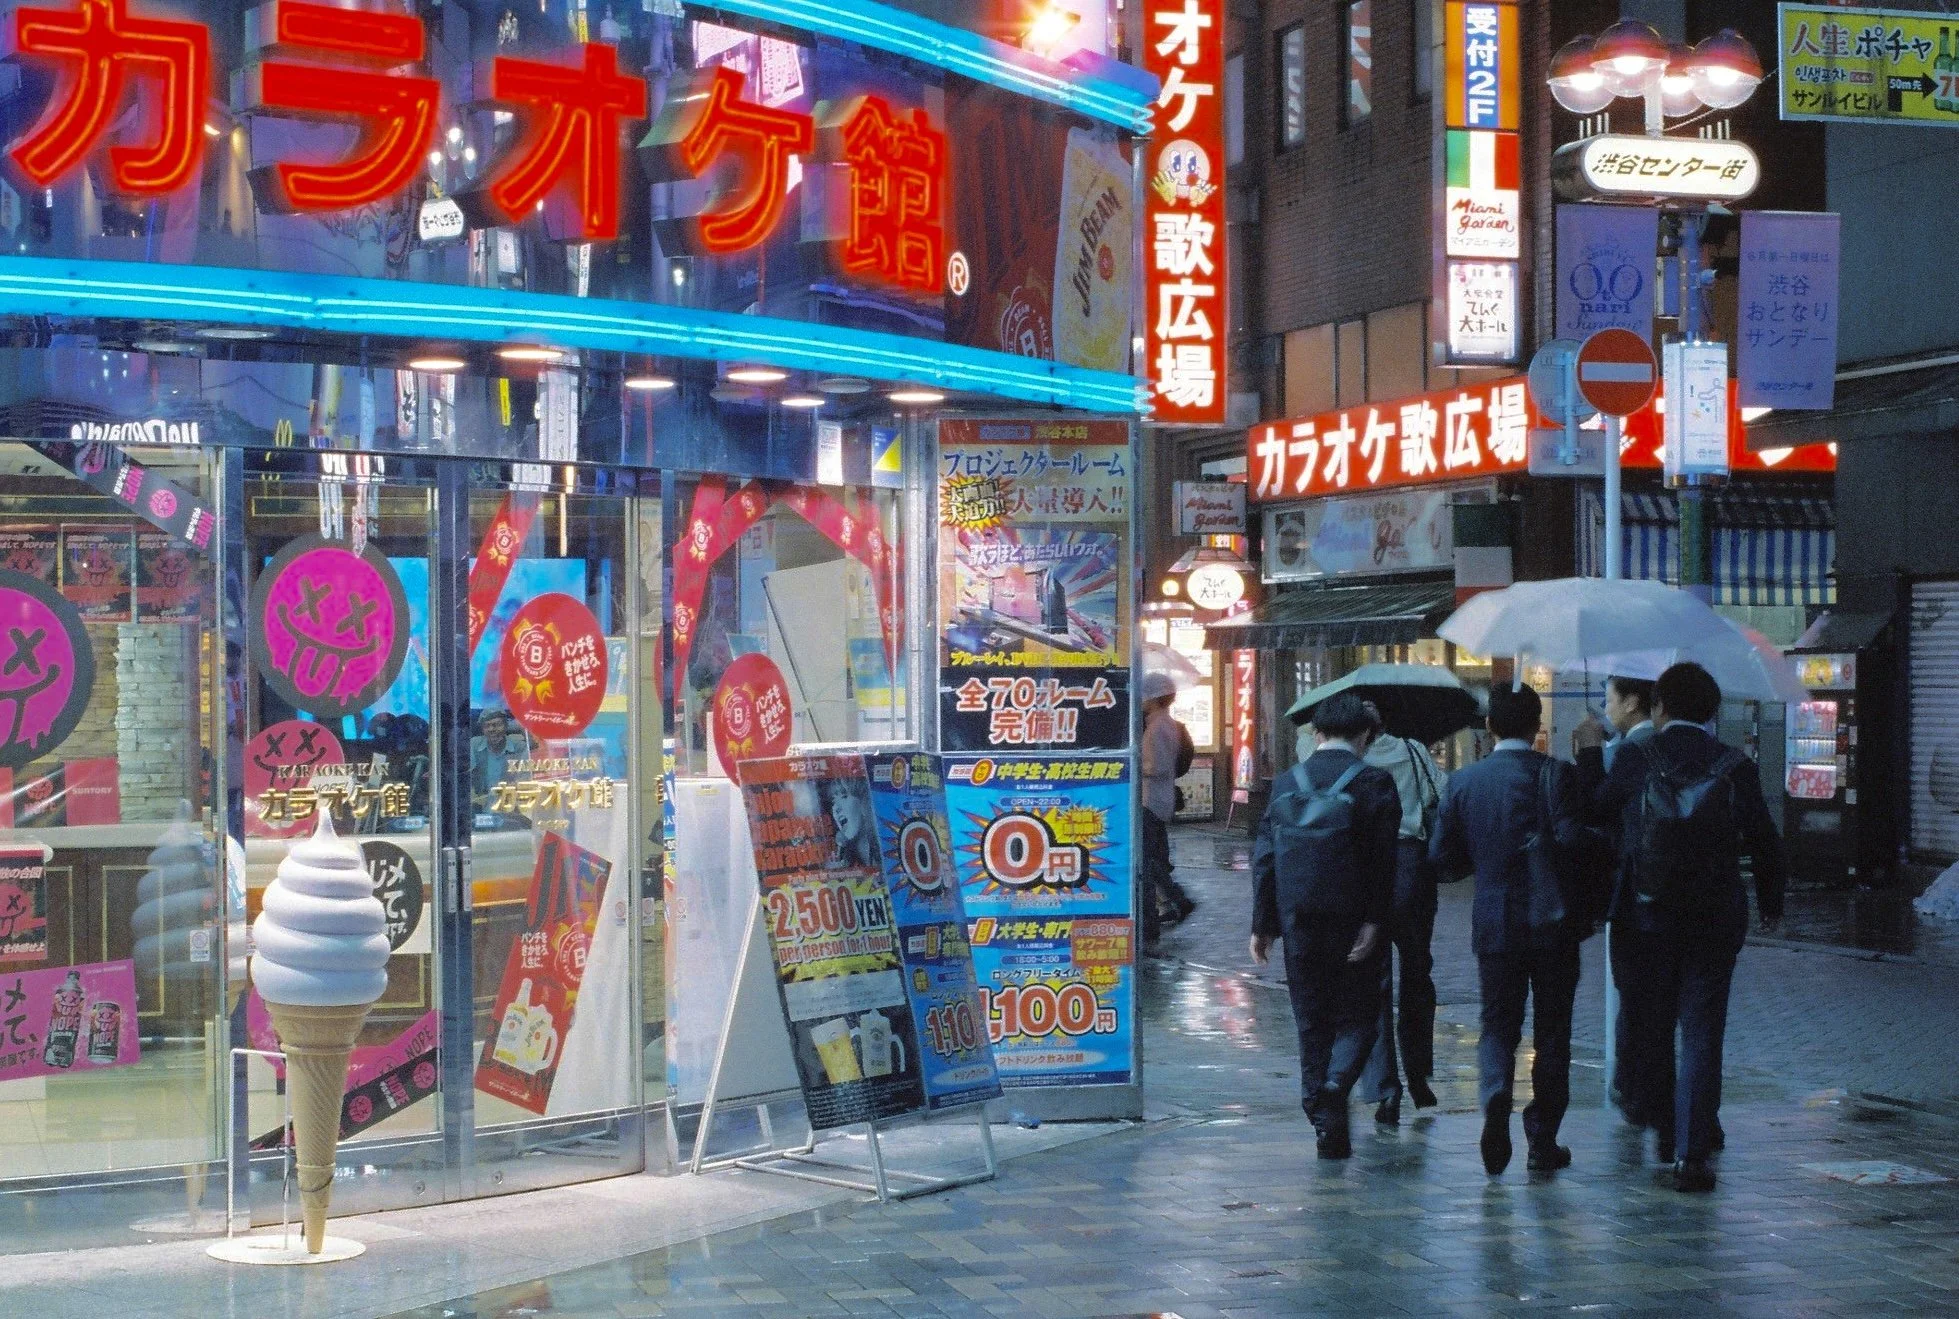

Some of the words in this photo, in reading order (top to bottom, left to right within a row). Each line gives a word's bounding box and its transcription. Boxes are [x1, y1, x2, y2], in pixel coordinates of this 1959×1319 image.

[1465, 6, 1498, 126] 受付2F
[1795, 66, 1847, 83] 인생포차
[1792, 89, 1883, 110] サンルイビル
[10, 0, 945, 292] カラオケ館
[1592, 153, 1748, 180] 渋谷センター街
[1079, 186, 1122, 249] BEAM
[1452, 199, 1505, 215] Miami
[1769, 274, 1810, 295] 渋谷
[1579, 303, 1632, 314] nari
[1746, 301, 1828, 321] おとなり
[1745, 328, 1829, 348] サンデー
[1255, 383, 1529, 497] カラオケ歌広場
[944, 449, 1126, 477] プロジェクタールーム
[560, 634, 595, 660] パンチを
[956, 676, 1116, 711] 全70ルーム
[988, 708, 1078, 744] 完備!!
[277, 764, 353, 778] KARAOKE
[996, 762, 1125, 780] 中学生・高校生限定
[72, 787, 113, 795] SUNTORY
[258, 783, 411, 821] カラオケ館
[490, 777, 614, 813] カラオケ館
[985, 815, 1080, 883] 0円
[768, 886, 858, 942] 2,500
[856, 895, 889, 931] YEN
[803, 942, 845, 961] person
[992, 968, 1082, 981] ロングフリータイム
